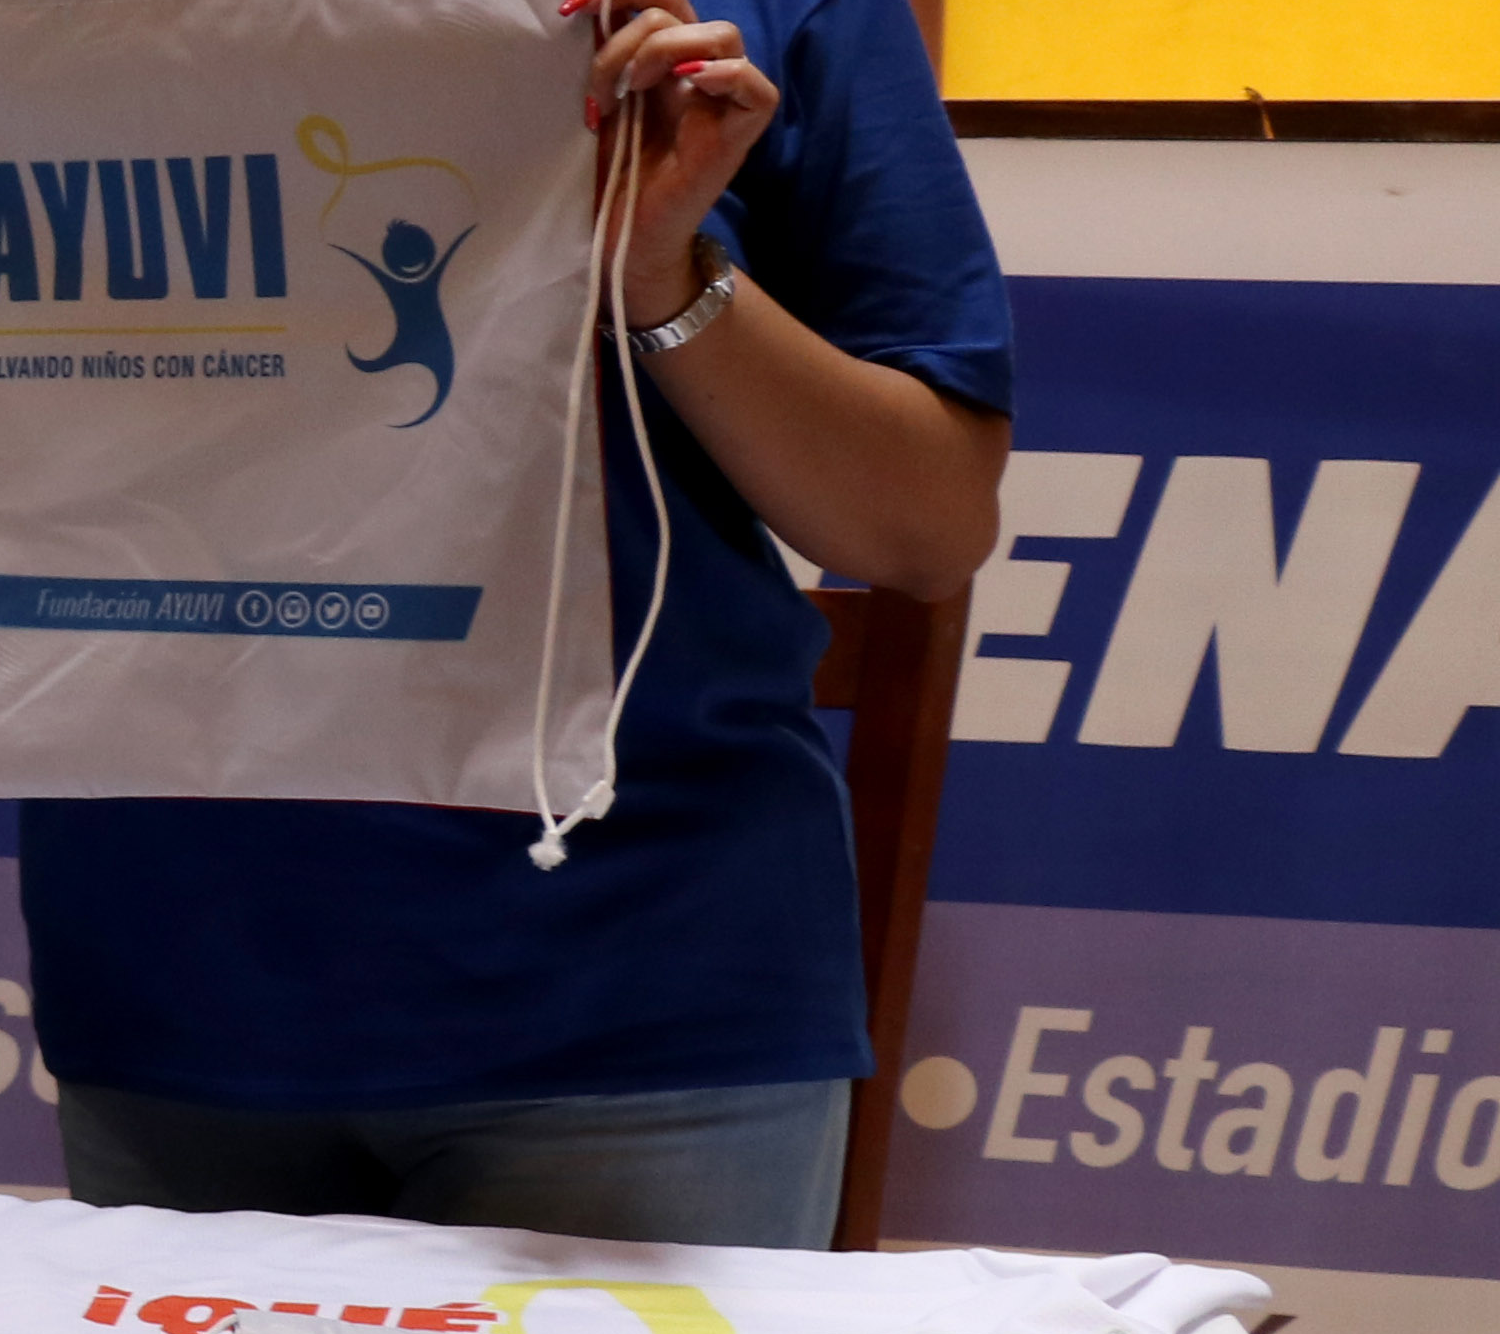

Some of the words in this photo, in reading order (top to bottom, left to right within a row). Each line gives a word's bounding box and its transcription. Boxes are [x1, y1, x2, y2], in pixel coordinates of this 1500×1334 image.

[81, 351, 146, 379] NIÑOS
[153, 354, 195, 378] CON
[202, 349, 287, 378] CÁNCER
[34, 587, 151, 620] Fundación
[156, 590, 226, 623] AYUVI
[982, 1005, 1500, 1192] Estadio
